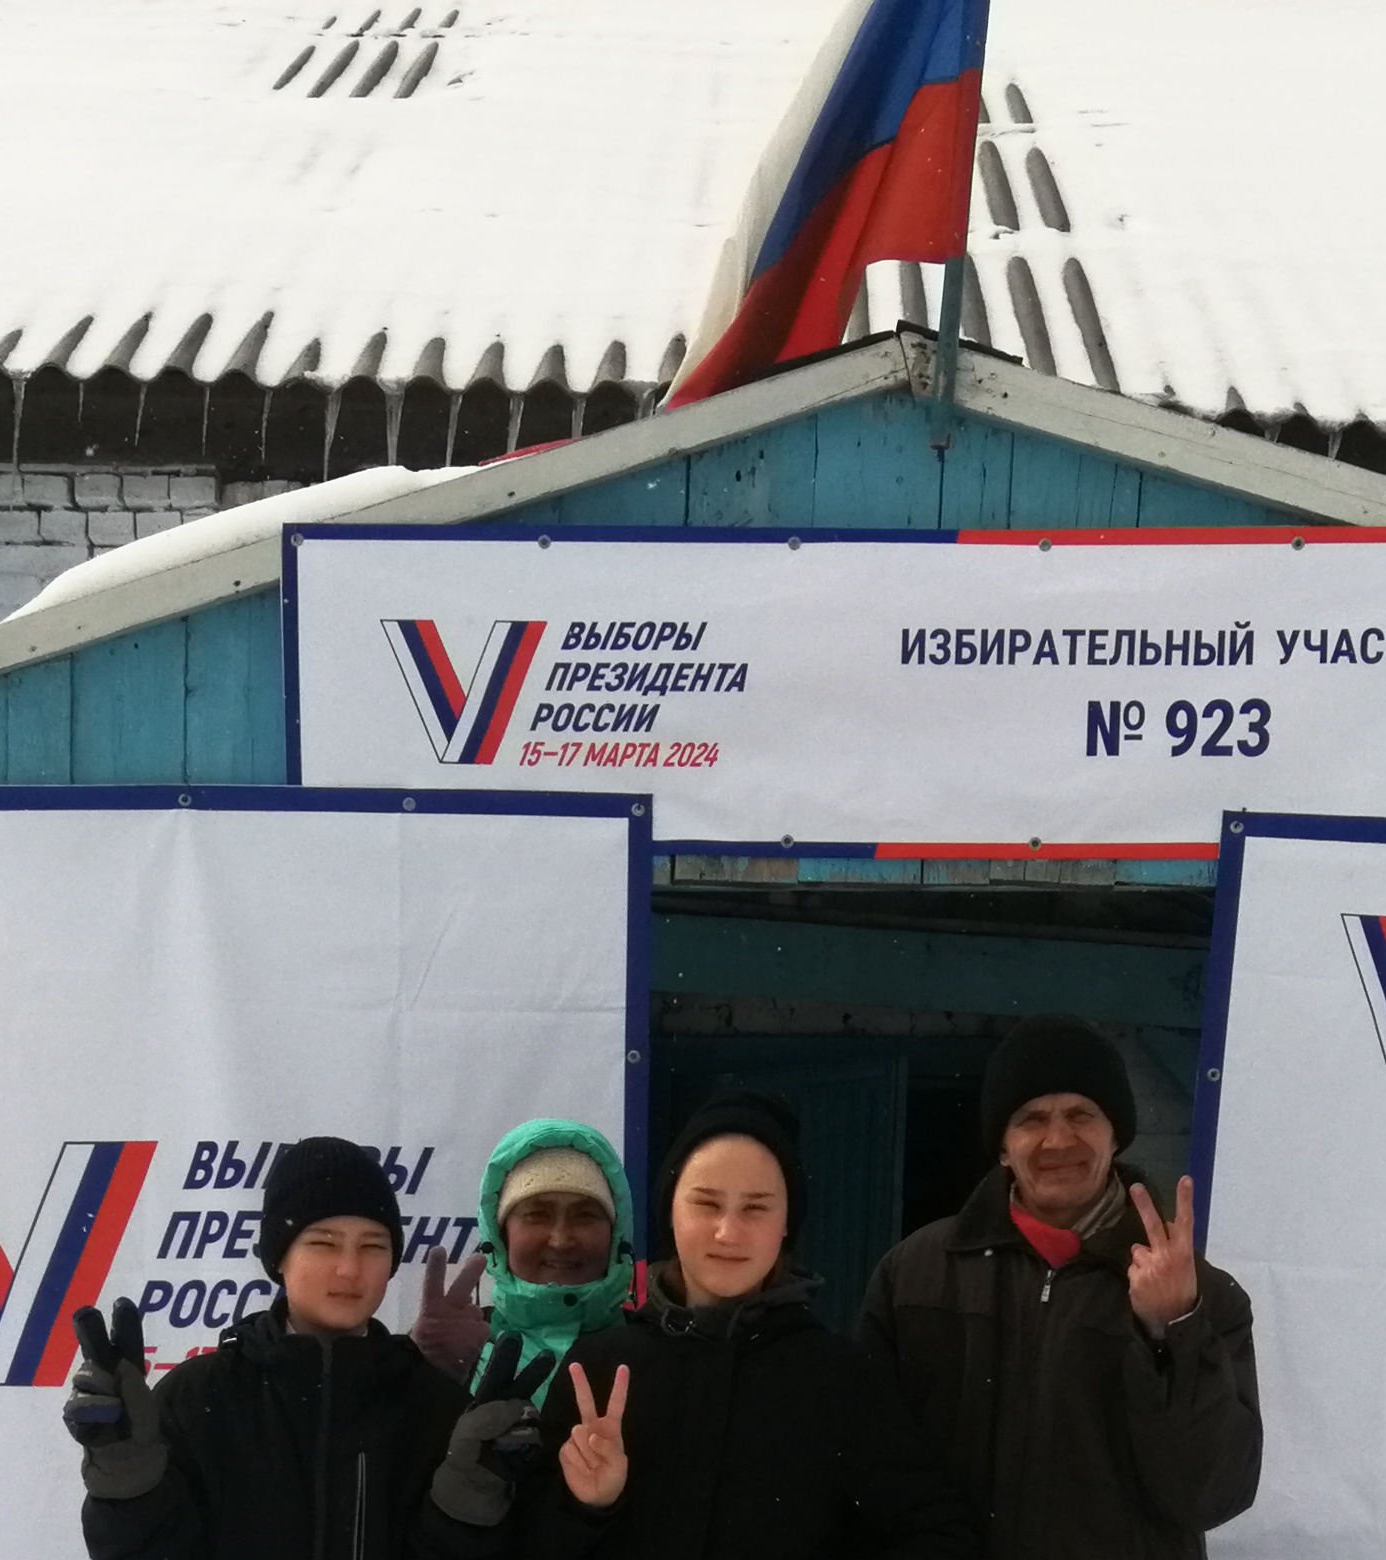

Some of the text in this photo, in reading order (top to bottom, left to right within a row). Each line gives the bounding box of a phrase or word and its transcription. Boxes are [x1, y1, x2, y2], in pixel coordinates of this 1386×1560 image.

[561, 621, 708, 651] ВЫБОРЫ
[900, 621, 1255, 666] ИЗБИРАТЕЛЬНЫЙ
[544, 662, 749, 697] ПРЕЗИДЕНТА
[529, 703, 661, 732] РОССИИ
[1086, 698, 1272, 758] № 923
[584, 742, 662, 768] МАРТА
[663, 742, 720, 768] 2024
[183, 1140, 436, 1195] ВЫЫ
[138, 1279, 286, 1329] РОСС
